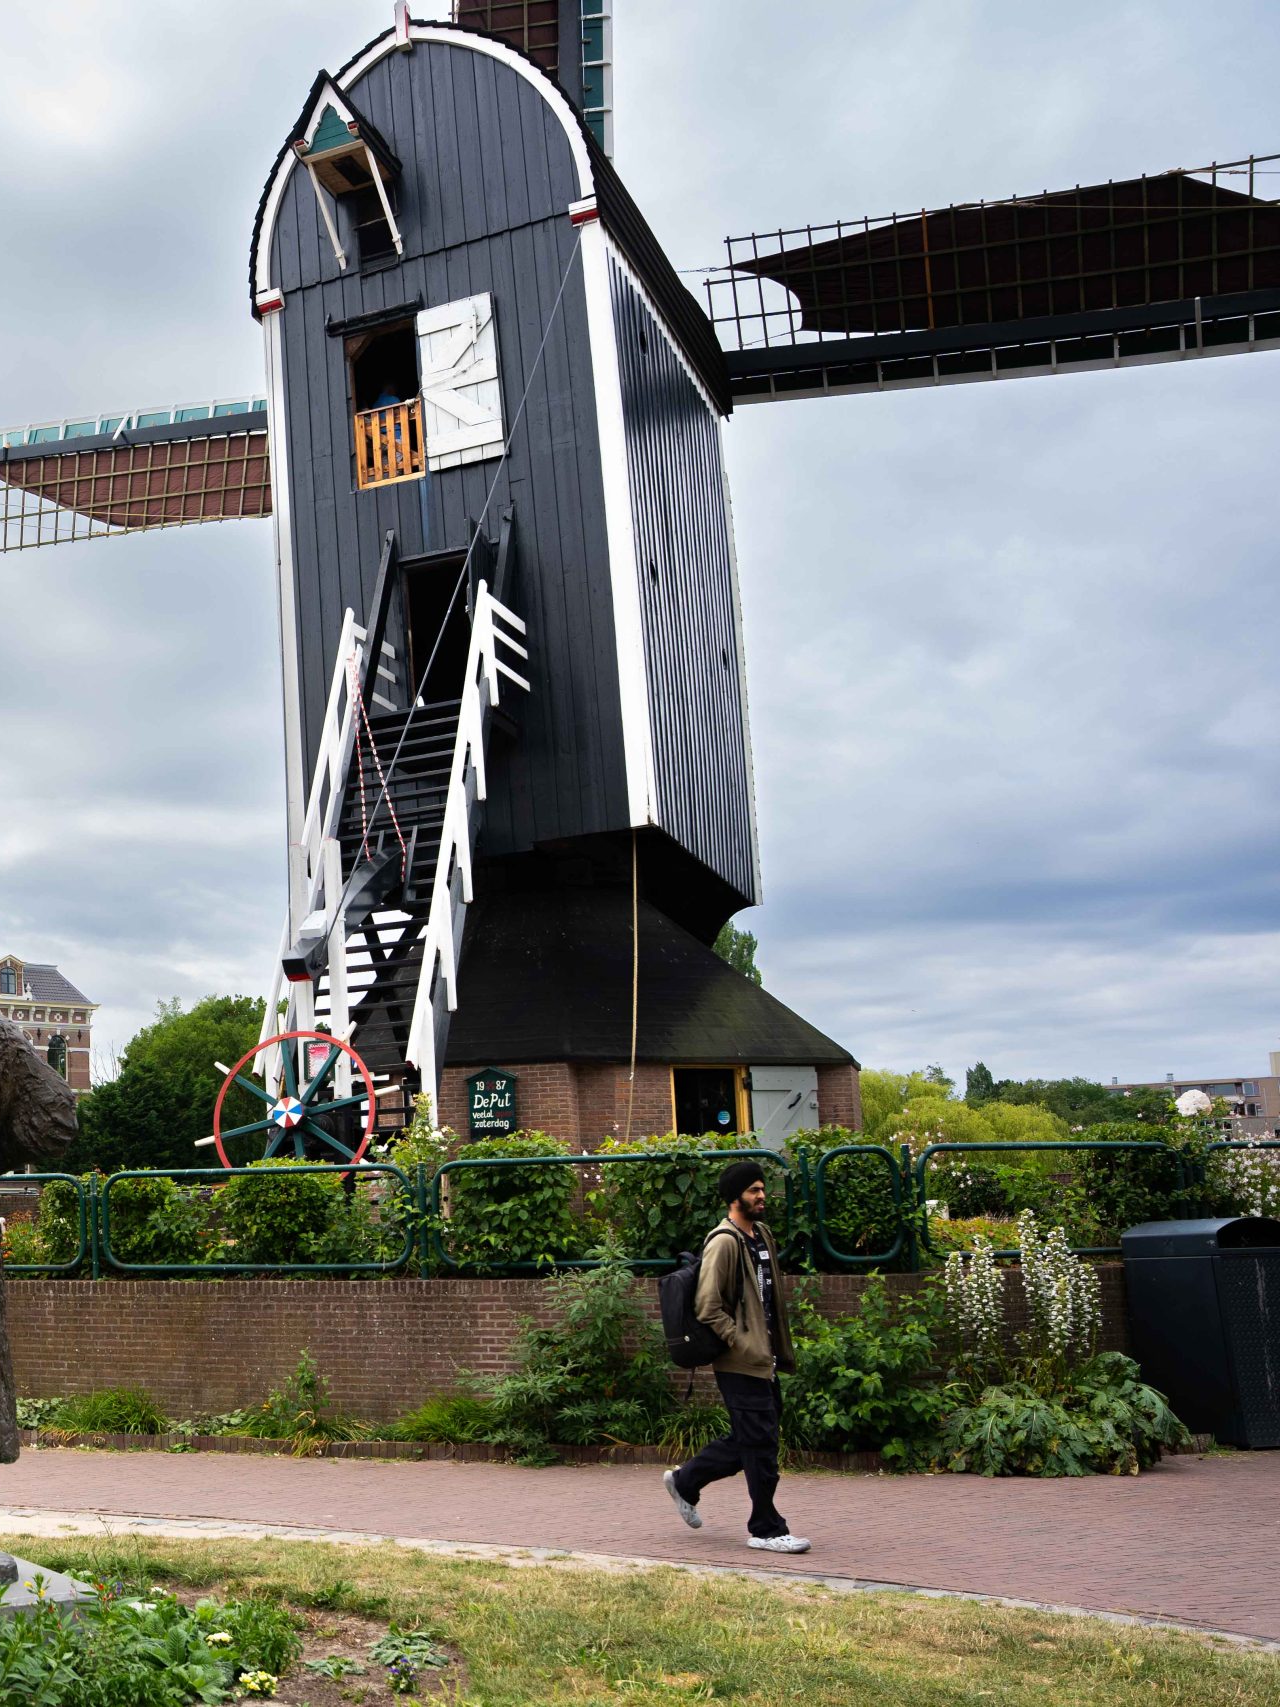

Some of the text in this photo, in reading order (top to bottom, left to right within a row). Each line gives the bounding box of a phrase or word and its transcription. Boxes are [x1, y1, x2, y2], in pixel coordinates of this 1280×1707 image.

[475, 1080, 507, 1091] 19 87
[473, 1092, 511, 1109] De Put
[472, 1109, 494, 1119] veelal
[474, 1119, 510, 1130] zaterdag
